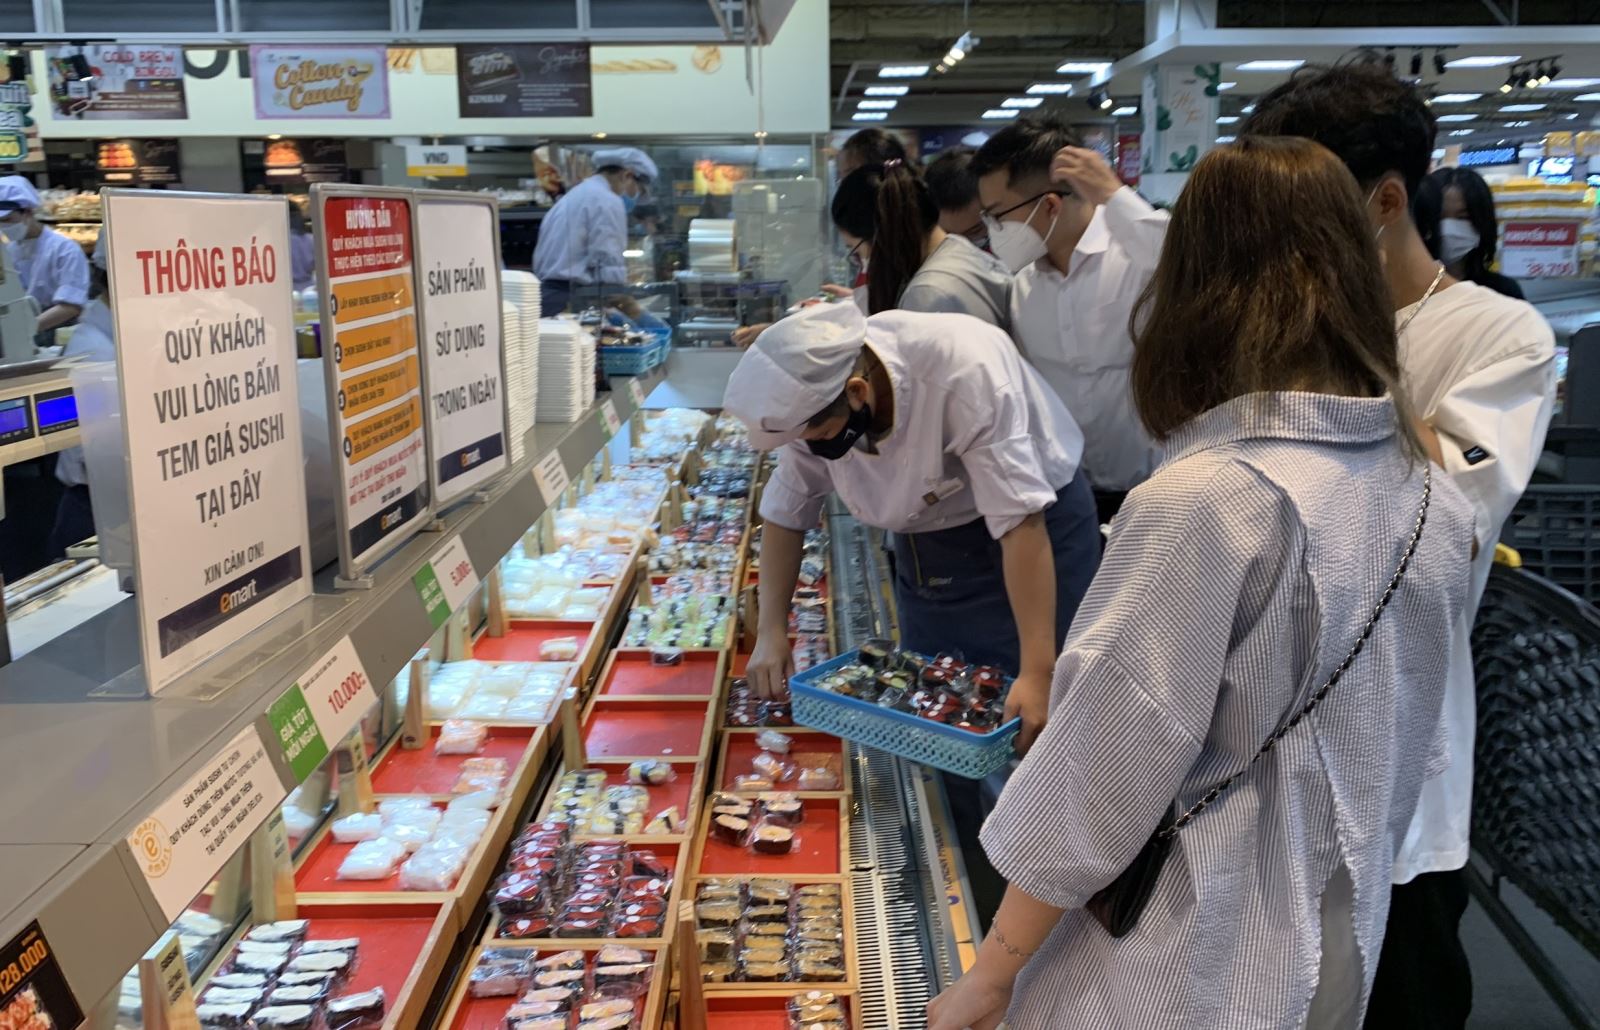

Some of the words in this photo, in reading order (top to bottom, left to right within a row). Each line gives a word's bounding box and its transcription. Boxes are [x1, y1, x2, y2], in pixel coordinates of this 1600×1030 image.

[274, 60, 346, 90] Cotton
[288, 79, 364, 112] Candy
[136, 239, 226, 295] THÔNG
[232, 236, 276, 286] BÁO
[428, 262, 451, 296] SẢN
[454, 258, 486, 294] PHẨM
[165, 319, 203, 364] QUÝ
[210, 313, 266, 355] KHÁCH
[436, 322, 452, 357] SỬ
[454, 324, 485, 358] DỤNG
[154, 386, 188, 424] VUI
[193, 373, 240, 415] LÒNG
[245, 358, 280, 401] BẤM
[432, 386, 467, 420] TRONG
[469, 373, 497, 409] NGÀY
[157, 438, 200, 481] TEM
[204, 422, 235, 467] GIÁ
[239, 413, 285, 455] SUSHI
[195, 485, 225, 528] TẠI
[230, 468, 262, 510] ĐÂY
[219, 579, 257, 613] emart
